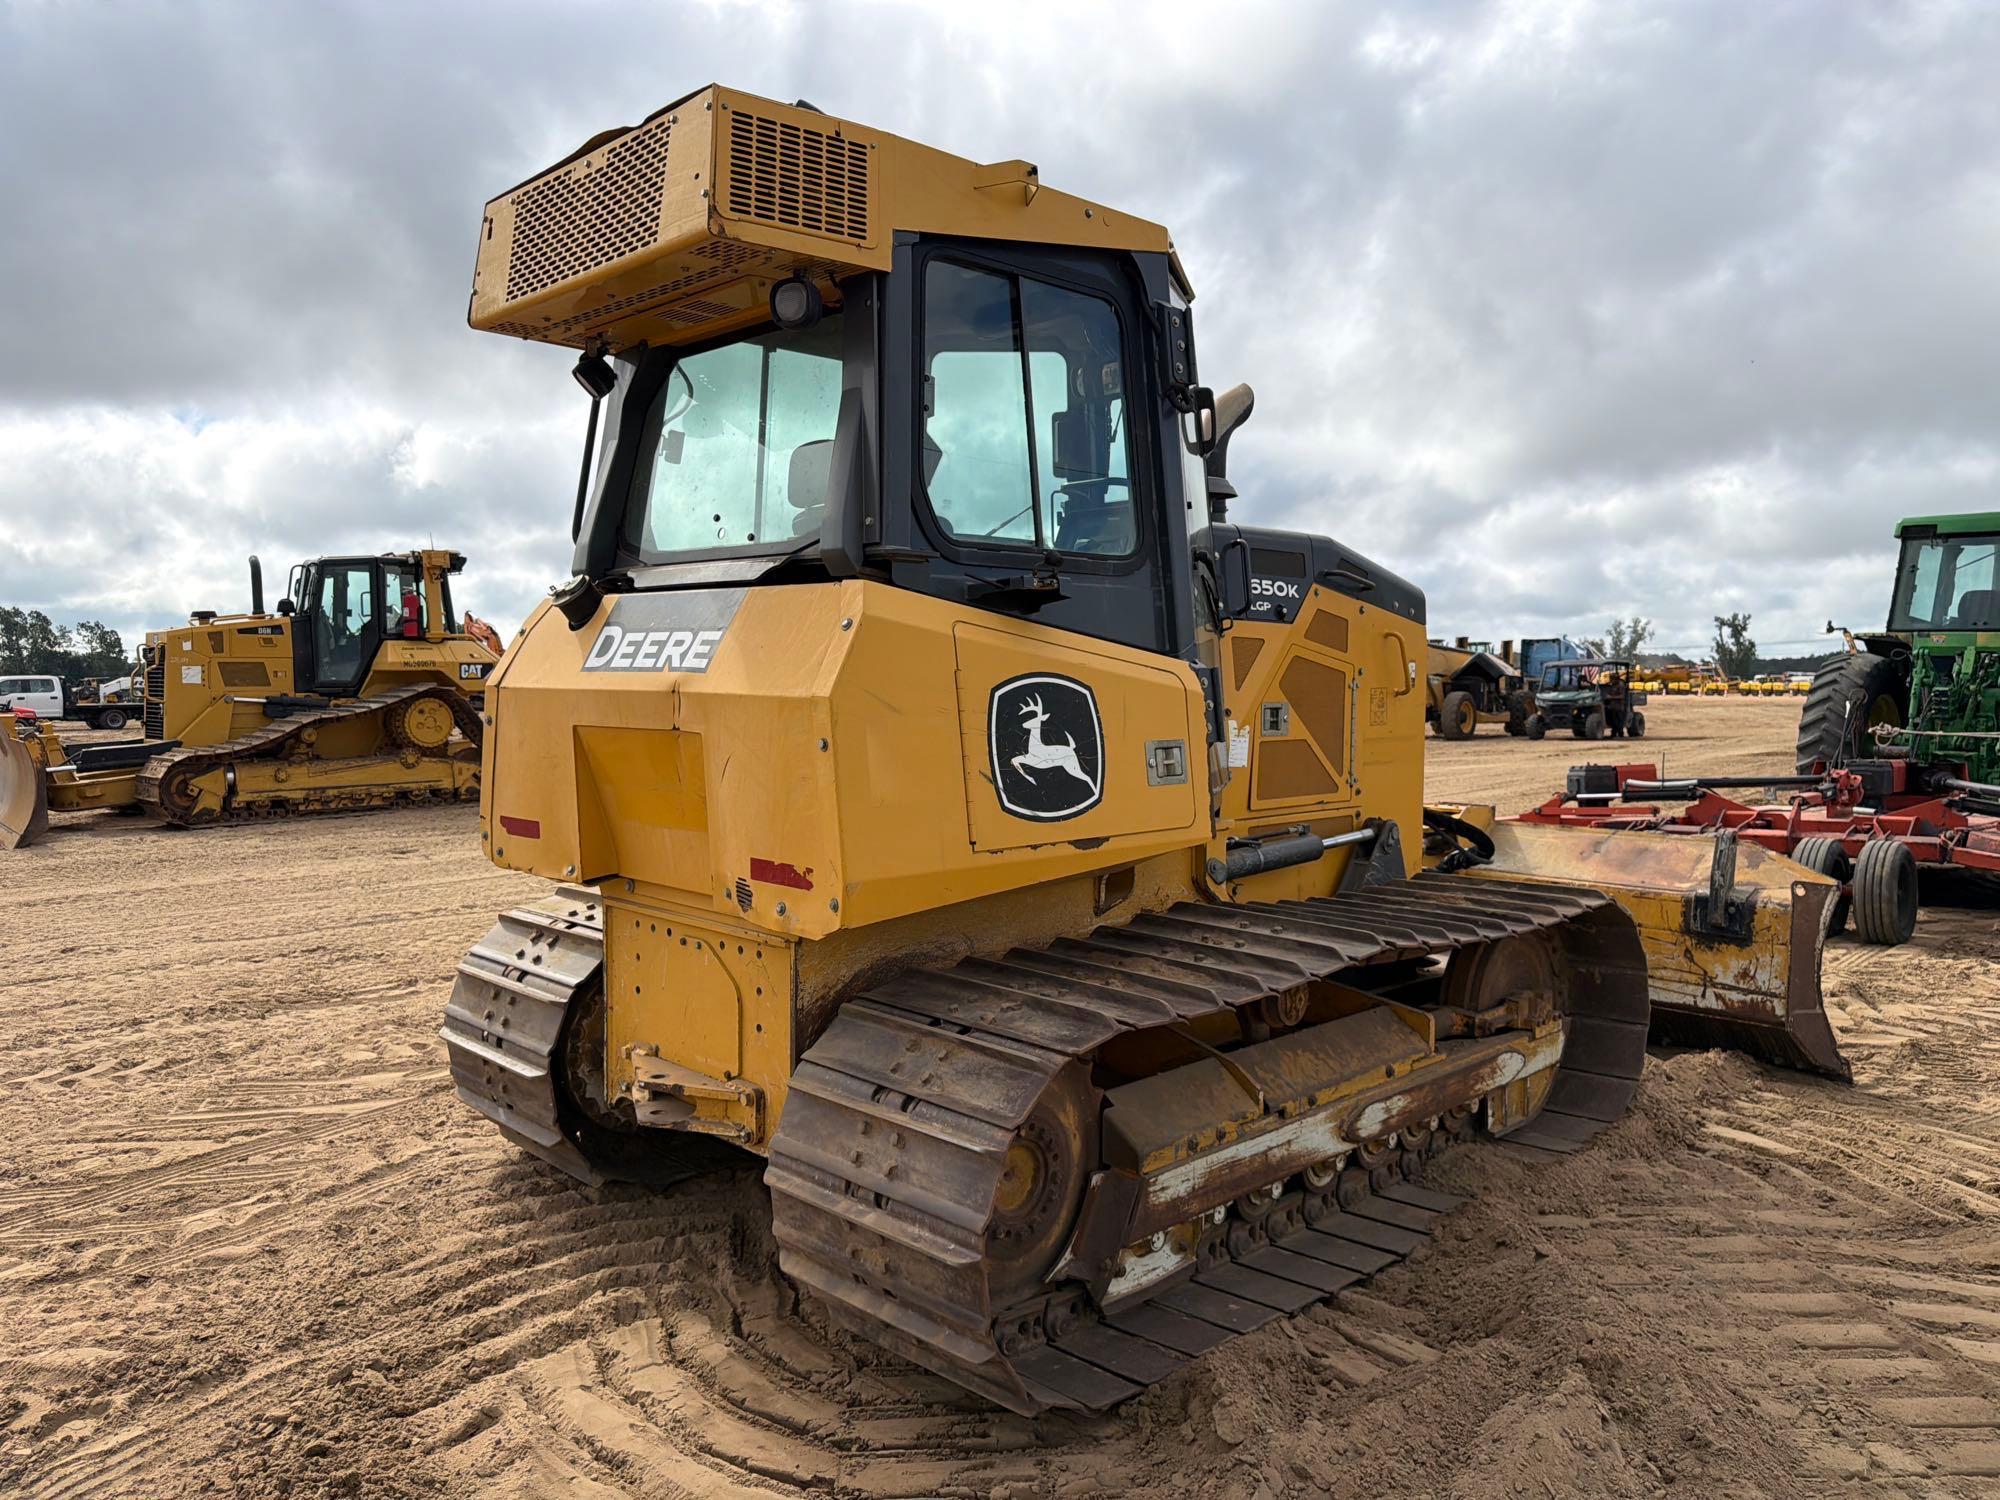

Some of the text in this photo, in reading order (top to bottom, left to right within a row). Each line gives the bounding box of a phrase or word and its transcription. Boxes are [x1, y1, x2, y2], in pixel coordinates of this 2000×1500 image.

[1250, 578, 1300, 599] 650K
[583, 625, 724, 669] DEERE
[460, 664, 483, 679] CAT
